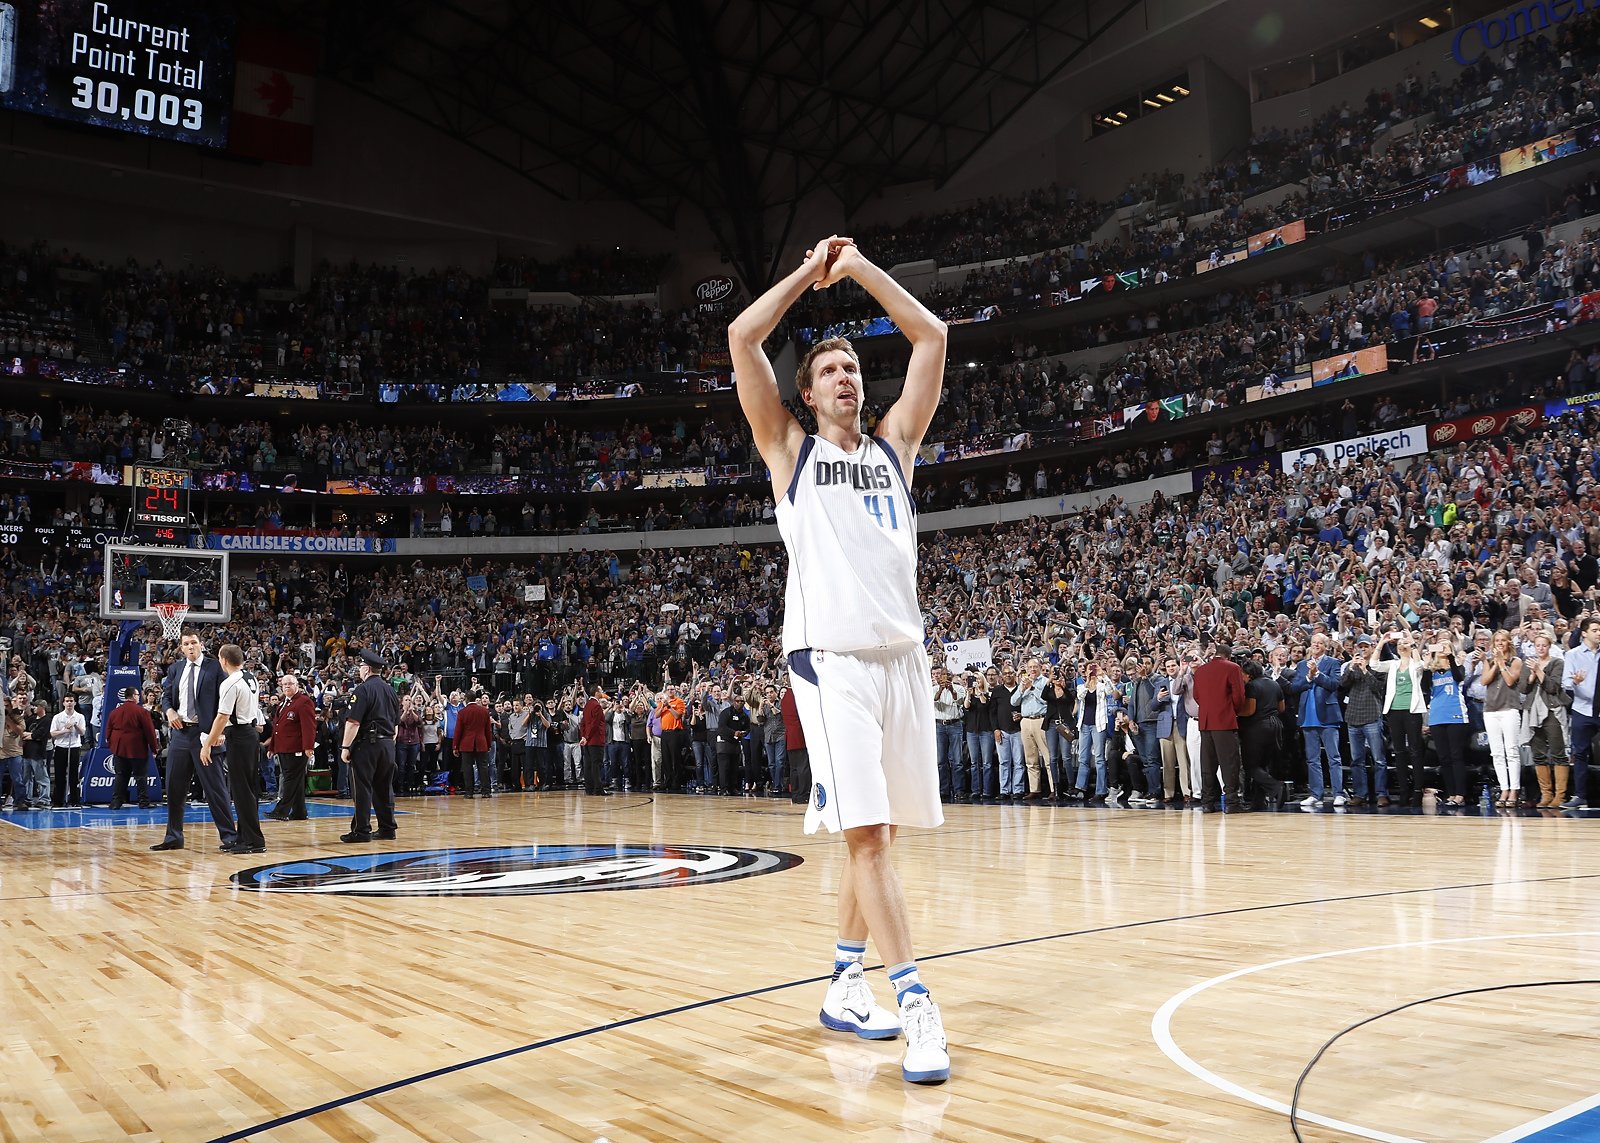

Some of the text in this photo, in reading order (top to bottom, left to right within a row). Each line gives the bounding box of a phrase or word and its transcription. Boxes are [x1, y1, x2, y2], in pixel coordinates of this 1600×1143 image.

[92, 2, 190, 53] Current
[71, 32, 204, 90] Point Total
[71, 76, 203, 131] 30,003
[698, 283, 730, 299] Pepper
[146, 486, 177, 510] 24
[151, 515, 186, 523] TISSOT
[863, 495, 898, 529] 41
[1, 534, 18, 544] 30
[221, 535, 366, 552] CARLISLE'S CORNER
